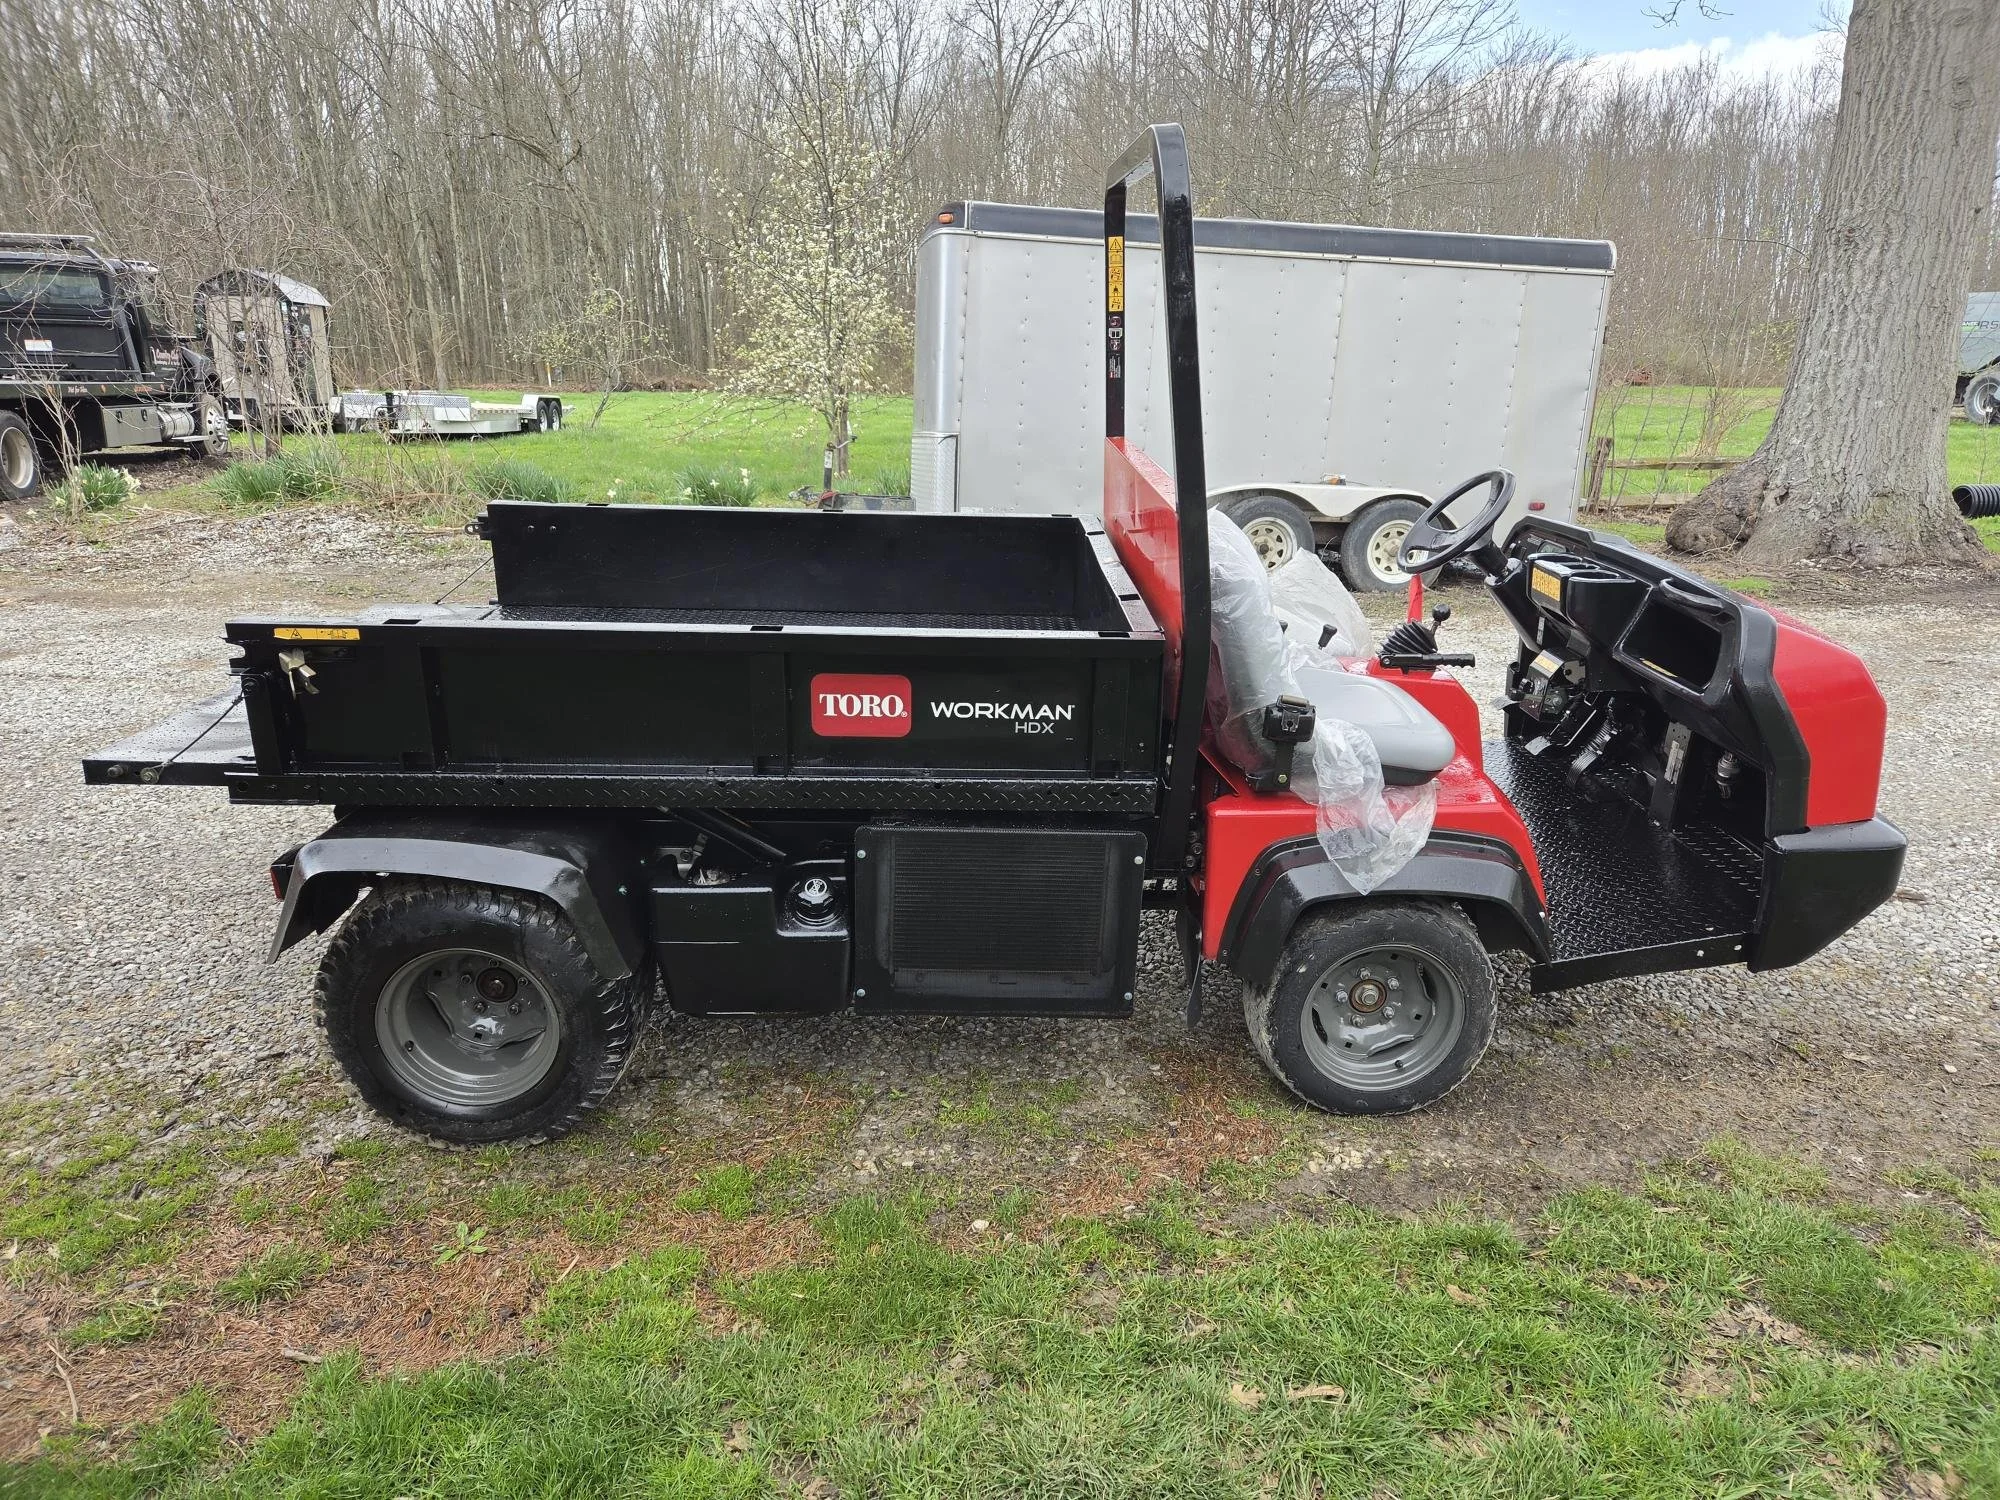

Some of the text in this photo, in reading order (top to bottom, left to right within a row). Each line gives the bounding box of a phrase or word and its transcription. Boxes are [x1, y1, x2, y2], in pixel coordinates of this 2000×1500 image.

[819, 694, 904, 717] TORO
[930, 702, 1072, 720] WORKMAN
[1015, 721, 1055, 734] HDX
